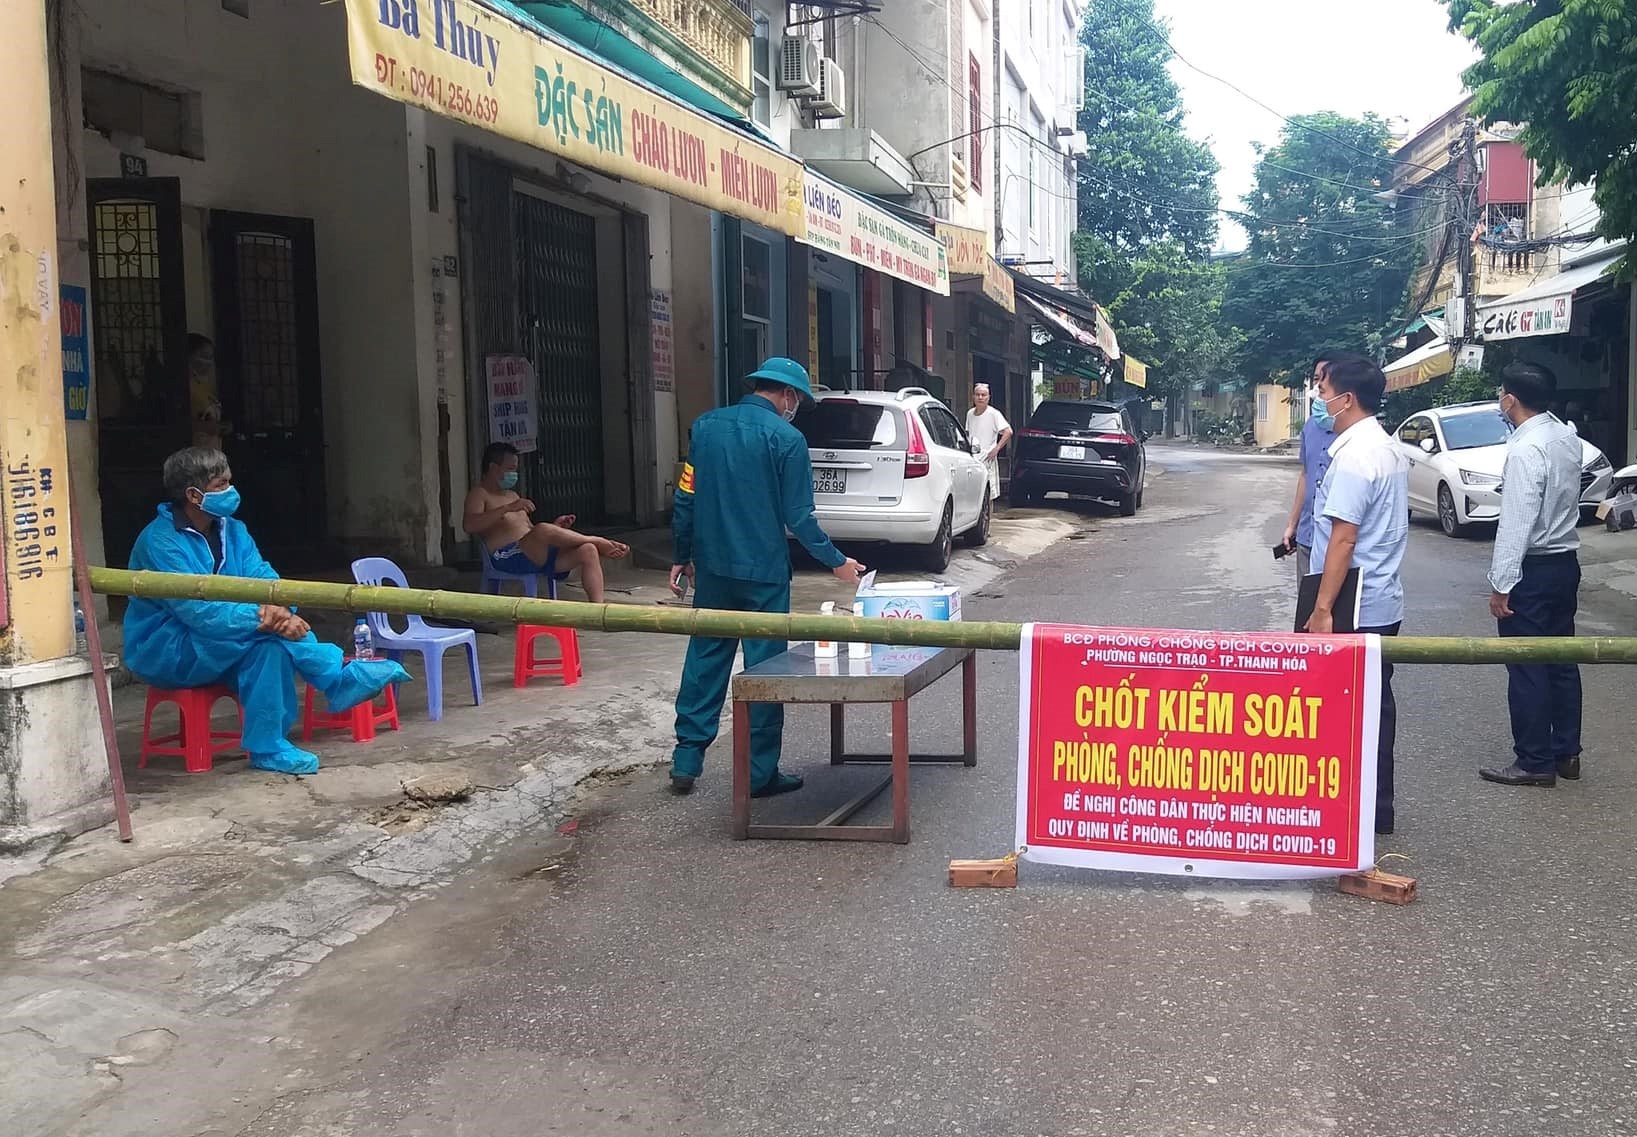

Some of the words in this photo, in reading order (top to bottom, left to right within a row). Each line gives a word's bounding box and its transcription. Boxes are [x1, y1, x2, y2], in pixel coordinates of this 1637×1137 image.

[409, 66, 499, 124] 0941.256.639
[534, 58, 580, 146] ĐẶC
[584, 75, 624, 156] SẢN
[630, 103, 670, 174] CHÁO
[720, 140, 749, 204] MIẾN
[126, 156, 145, 176] 94
[807, 183, 826, 214] LIÊN
[826, 192, 842, 220] BÉO
[1520, 310, 1533, 333] 67
[819, 469, 839, 481] 36A
[1063, 632, 1094, 645] BCĐ
[1098, 632, 1155, 649] PHÒNG,
[1158, 633, 1217, 650] CHỐNG
[1219, 639, 1256, 654] DỊCH
[1260, 641, 1334, 656] COVID-19
[1086, 646, 1136, 663] PHƯỜNG
[1139, 651, 1173, 667] NGỌC
[1175, 652, 1207, 668] TRẠO
[1219, 654, 1279, 669] TP.THANH
[1281, 655, 1308, 671] HÓA
[1075, 672, 1151, 730] CHỐT
[1158, 673, 1234, 735] KIỂM
[1243, 687, 1323, 739] SOÁT
[1053, 731, 1122, 791] PHÒNG,
[1127, 731, 1193, 791] CHỐNG
[1198, 749, 1245, 802] DỊCH
[1250, 751, 1340, 800] COVID-19
[1063, 788, 1082, 811] ĐỀ
[1084, 794, 1116, 818] NGHỊ
[1119, 794, 1156, 817] CÔNG
[1159, 797, 1188, 819] DÂN
[1191, 802, 1227, 825] THỰC
[1230, 802, 1263, 827] HIỆN
[1266, 805, 1321, 828] NGHIÊM
[1048, 818, 1074, 838] QUY
[1077, 820, 1109, 842] ĐỊNH
[1112, 818, 1130, 841] VỀ
[1132, 822, 1182, 848] PHÒNG,
[1186, 824, 1233, 849] CHỐNG
[1236, 832, 1269, 855] DỊCH
[1272, 834, 1337, 856] COVID-19
